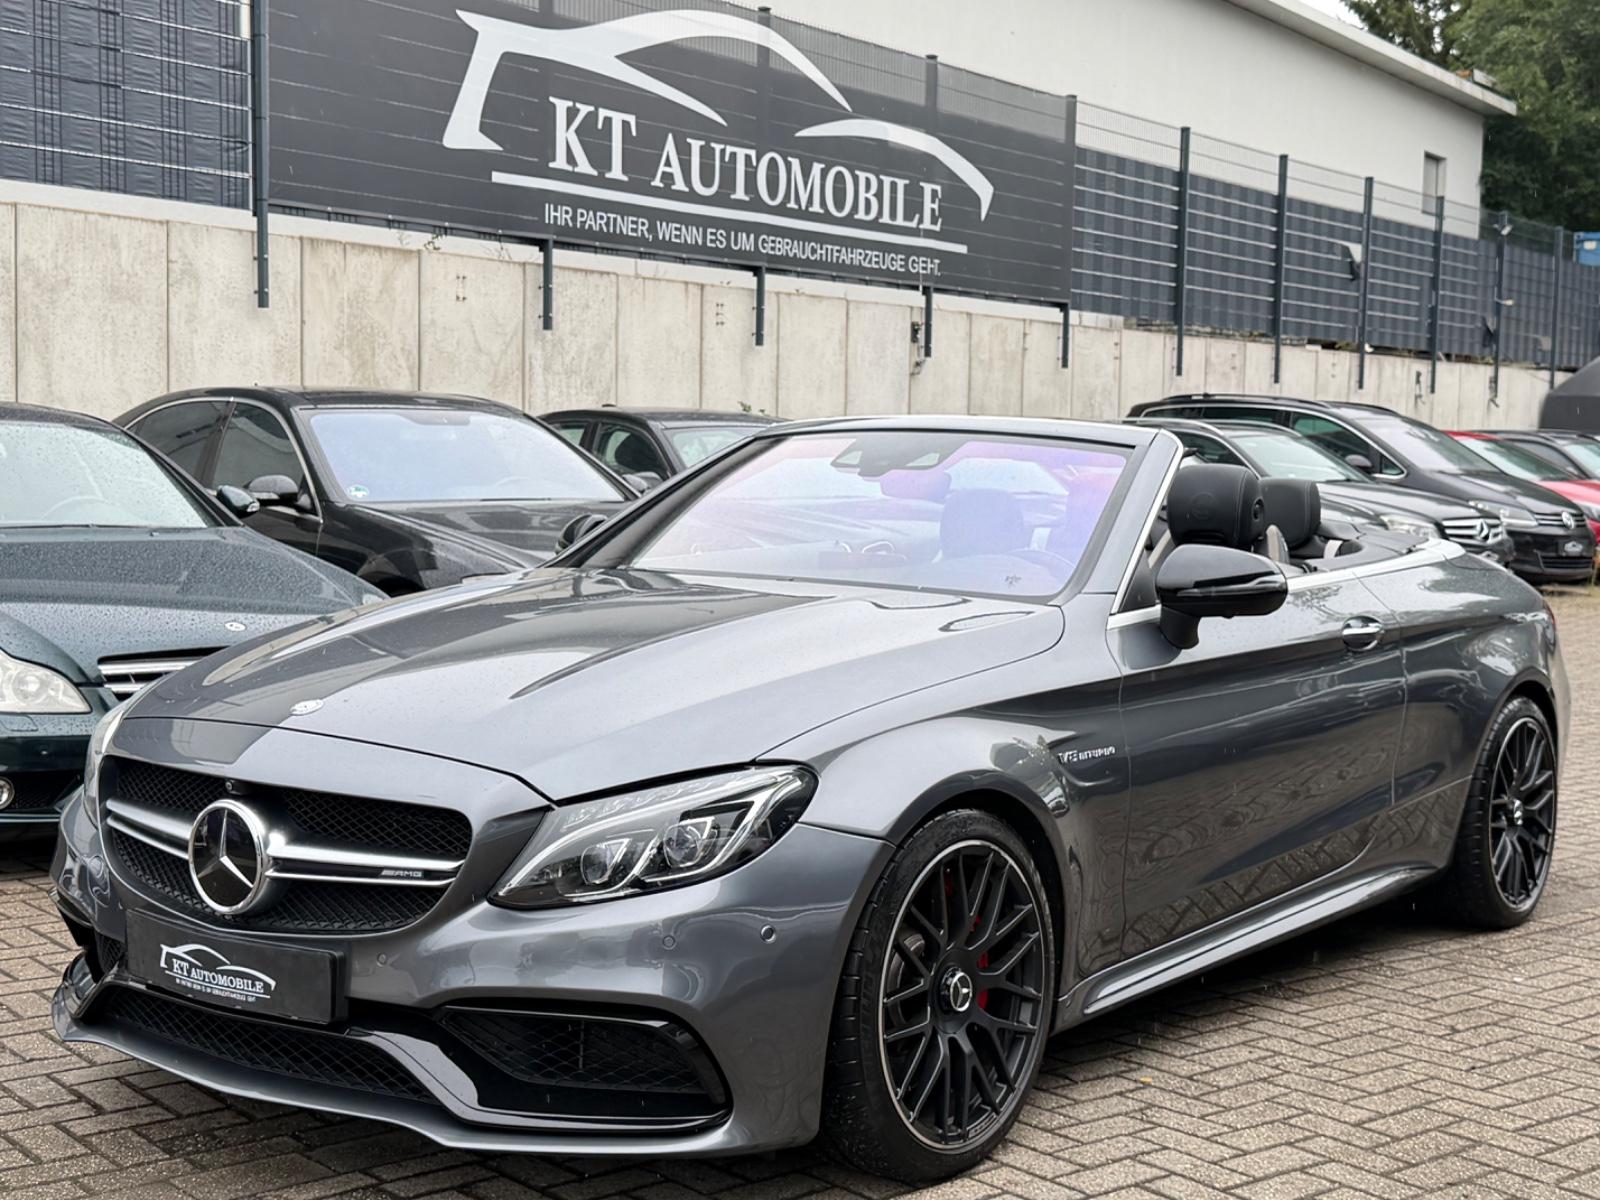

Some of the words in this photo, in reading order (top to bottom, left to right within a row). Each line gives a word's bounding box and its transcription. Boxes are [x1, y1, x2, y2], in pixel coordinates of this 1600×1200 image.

[548, 95, 637, 182] KT
[650, 132, 943, 233] AUTOMOBILE
[544, 203, 573, 228] IHR
[576, 208, 653, 242] PARTNER,
[656, 220, 703, 246] WENN
[706, 228, 727, 249] ES
[730, 231, 755, 252] UM
[758, 234, 906, 273] GEBRAUCHTFAHRZEUGE
[908, 256, 941, 277] GEHT.
[393, 869, 423, 878] AMG
[171, 958, 190, 977] KT
[190, 967, 265, 994] AUTOMOBILE
